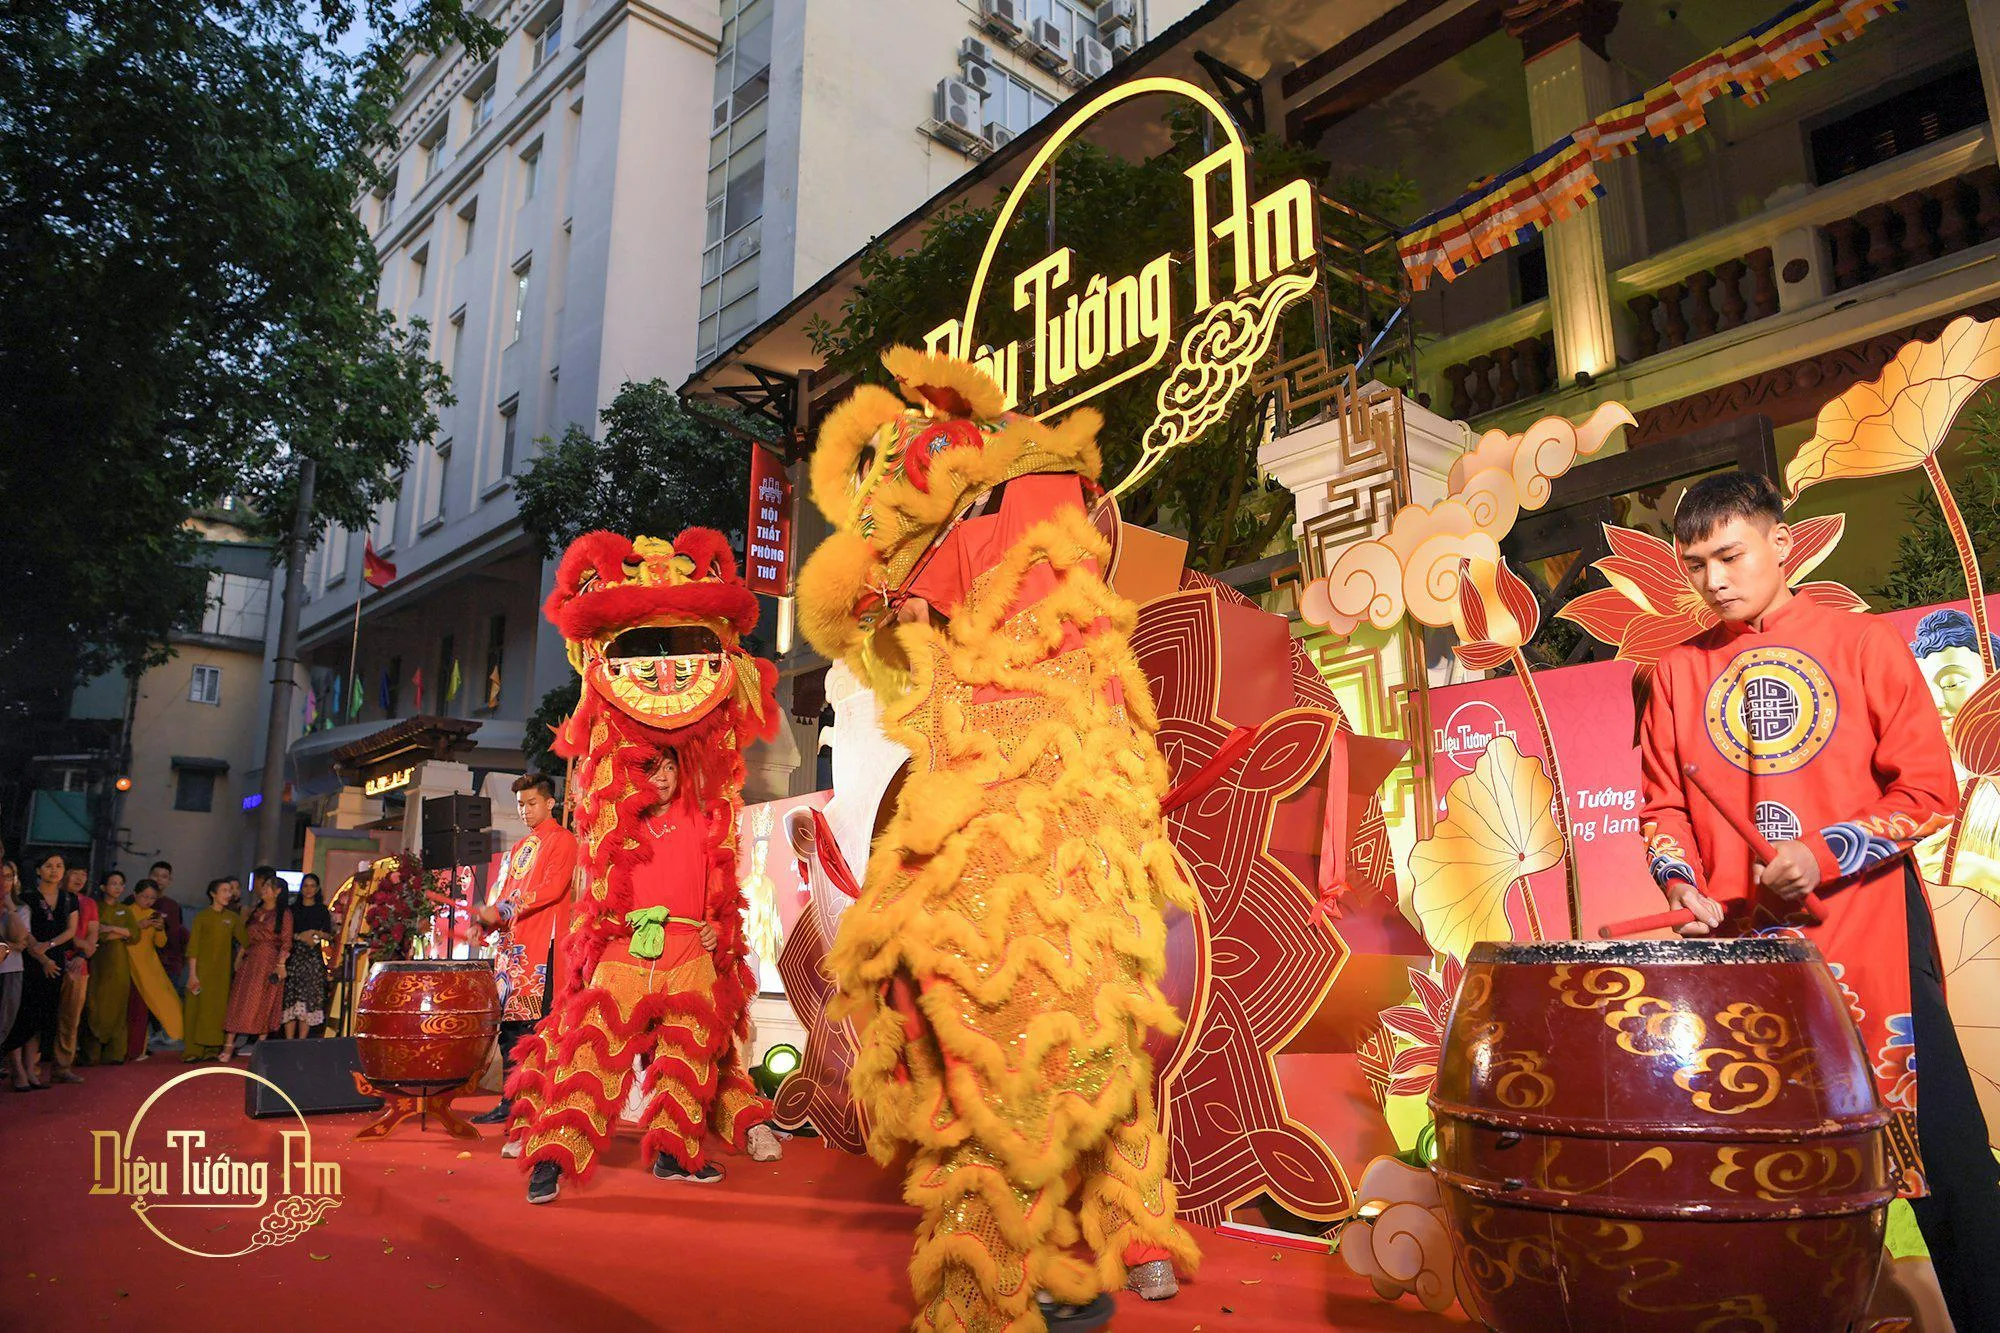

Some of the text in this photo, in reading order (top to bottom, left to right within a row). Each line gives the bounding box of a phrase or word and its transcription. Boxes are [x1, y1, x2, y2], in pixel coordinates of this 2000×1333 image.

[1014, 246, 1172, 397] Tướng
[761, 507, 778, 524] NỘI
[1577, 786, 1637, 811] Tướng
